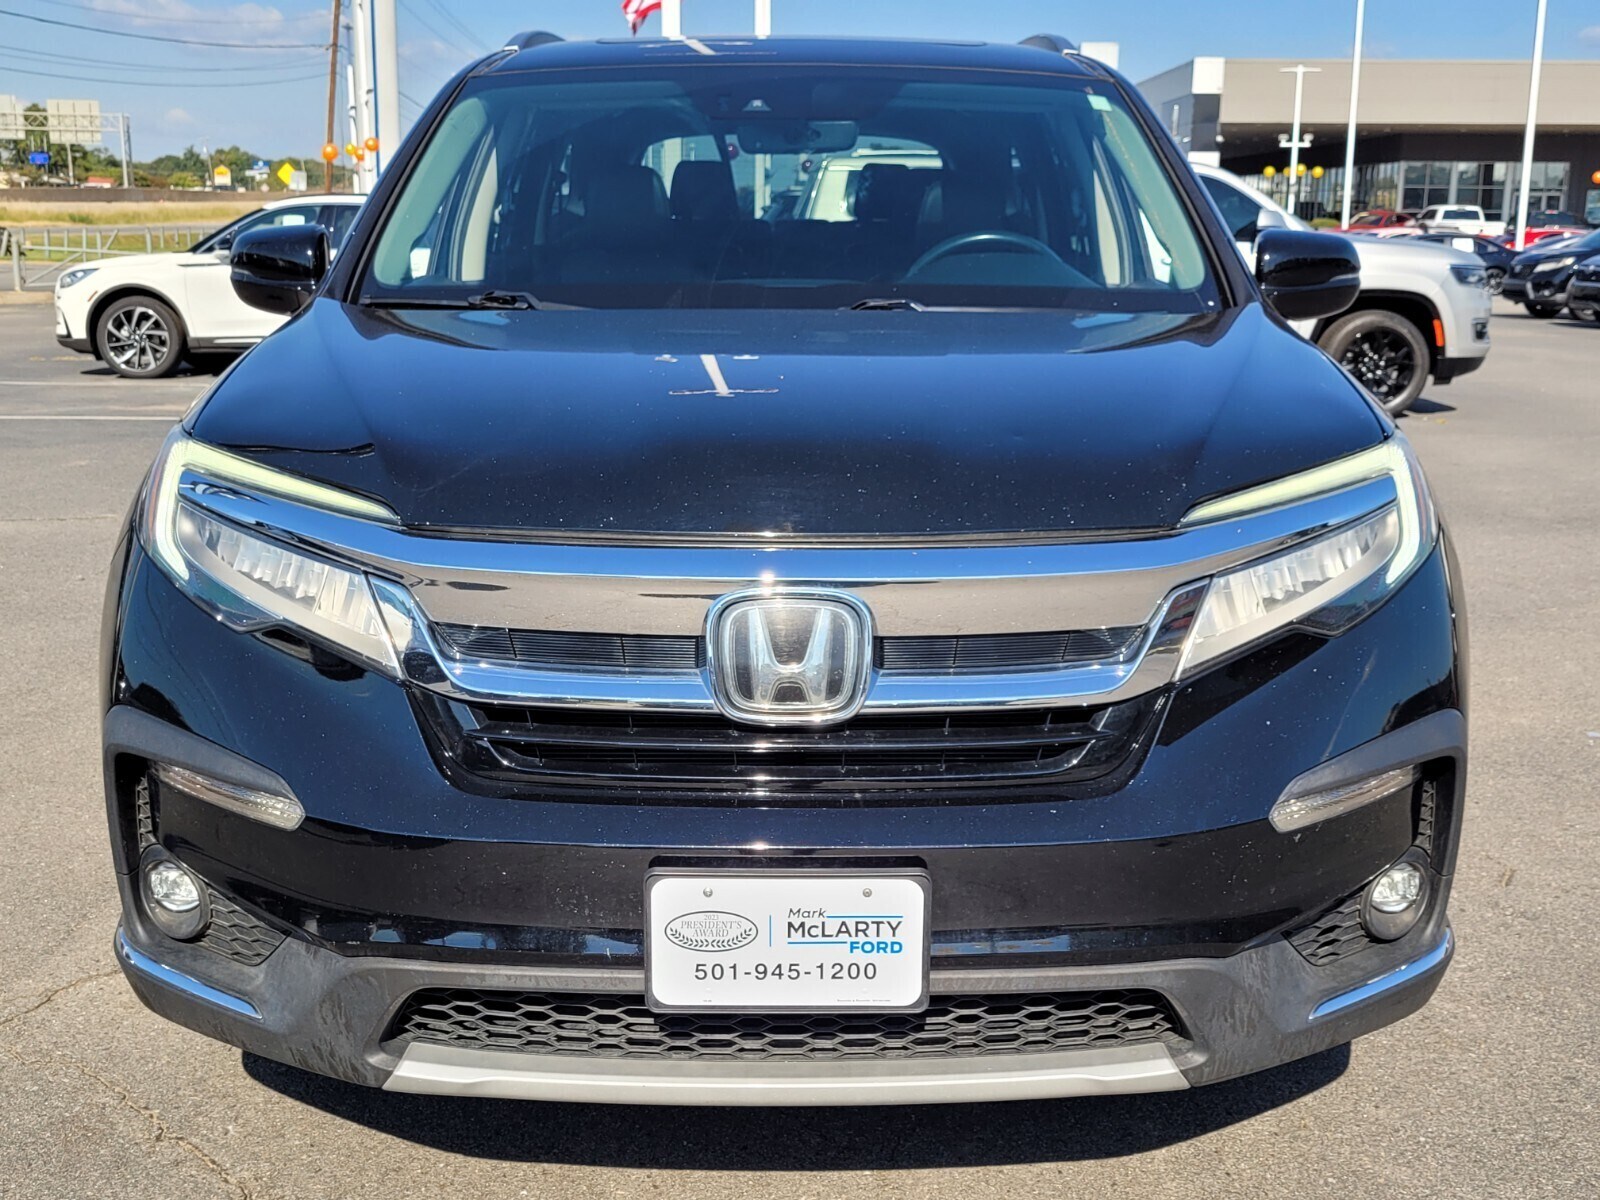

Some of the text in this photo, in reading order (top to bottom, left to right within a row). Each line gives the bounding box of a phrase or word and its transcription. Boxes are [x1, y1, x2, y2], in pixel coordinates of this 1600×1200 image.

[788, 908, 826, 918] Mark
[680, 920, 742, 929] PRESIDENT'S
[787, 921, 902, 938] McLARTY
[692, 929, 729, 937] AWARD
[849, 941, 903, 954] FORD
[694, 962, 877, 980] 501-945-1200
